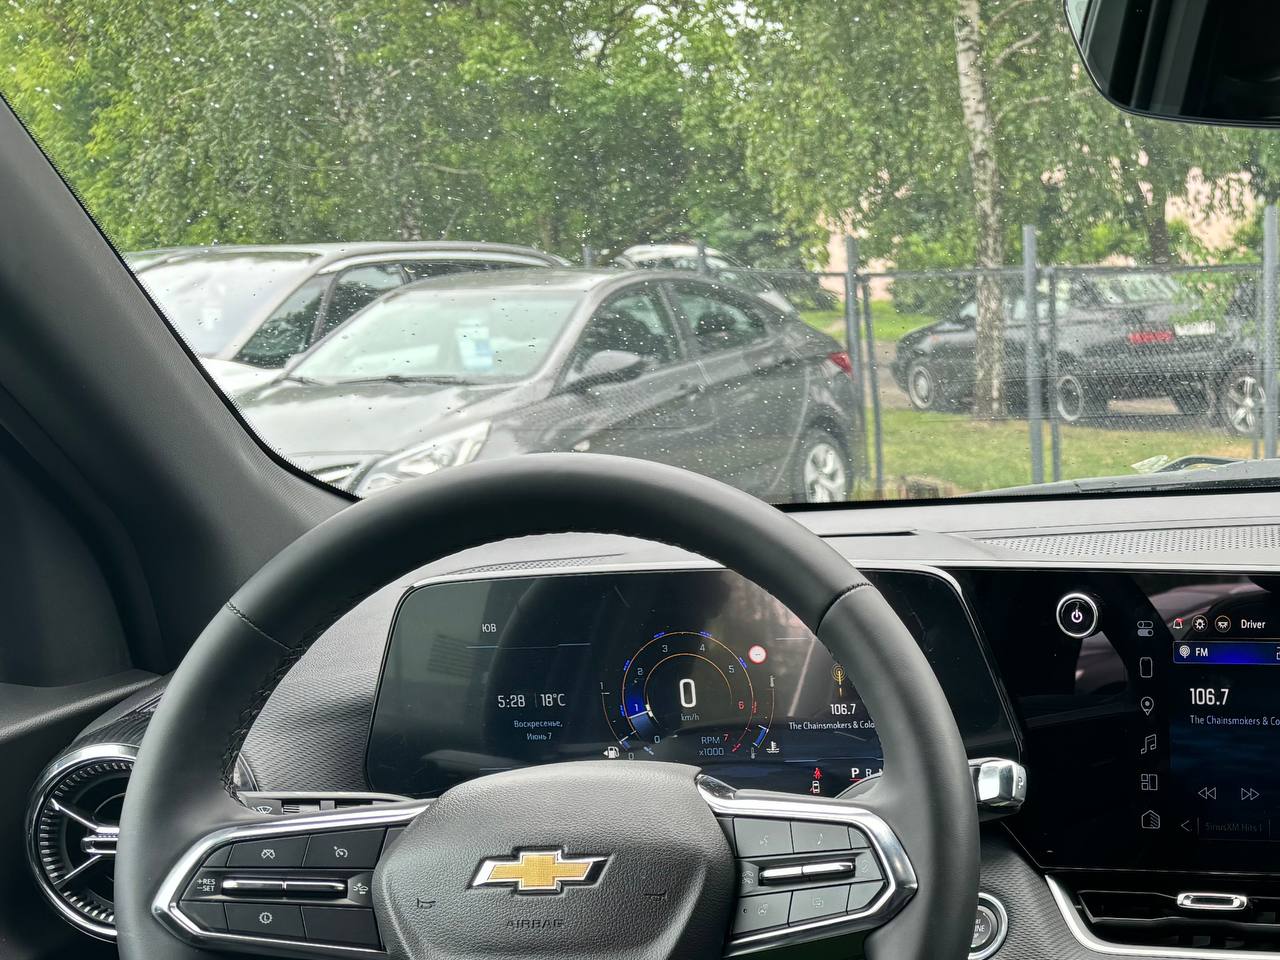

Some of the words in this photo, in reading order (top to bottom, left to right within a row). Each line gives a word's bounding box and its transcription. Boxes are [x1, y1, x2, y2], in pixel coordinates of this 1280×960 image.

[481, 623, 497, 633] ЮВ
[1240, 620, 1266, 630] Driver
[1195, 647, 1208, 658] FM
[678, 679, 697, 708] 0
[1189, 688, 1229, 707] 106.7
[497, 695, 526, 708] 5:28
[540, 693, 567, 707] 18°C
[830, 703, 857, 715] 106.7
[681, 713, 700, 722] km/h
[1190, 715, 1205, 726] The
[1206, 715, 1261, 727] Chainsmokers
[1262, 716, 1269, 727] &
[789, 722, 802, 731] The
[803, 721, 852, 730] Chainsmokers
[853, 721, 859, 729] &
[526, 732, 547, 741] Июнь
[701, 736, 721, 745] RPM
[851, 767, 860, 778] P
[507, 919, 564, 929] AIRBAG
